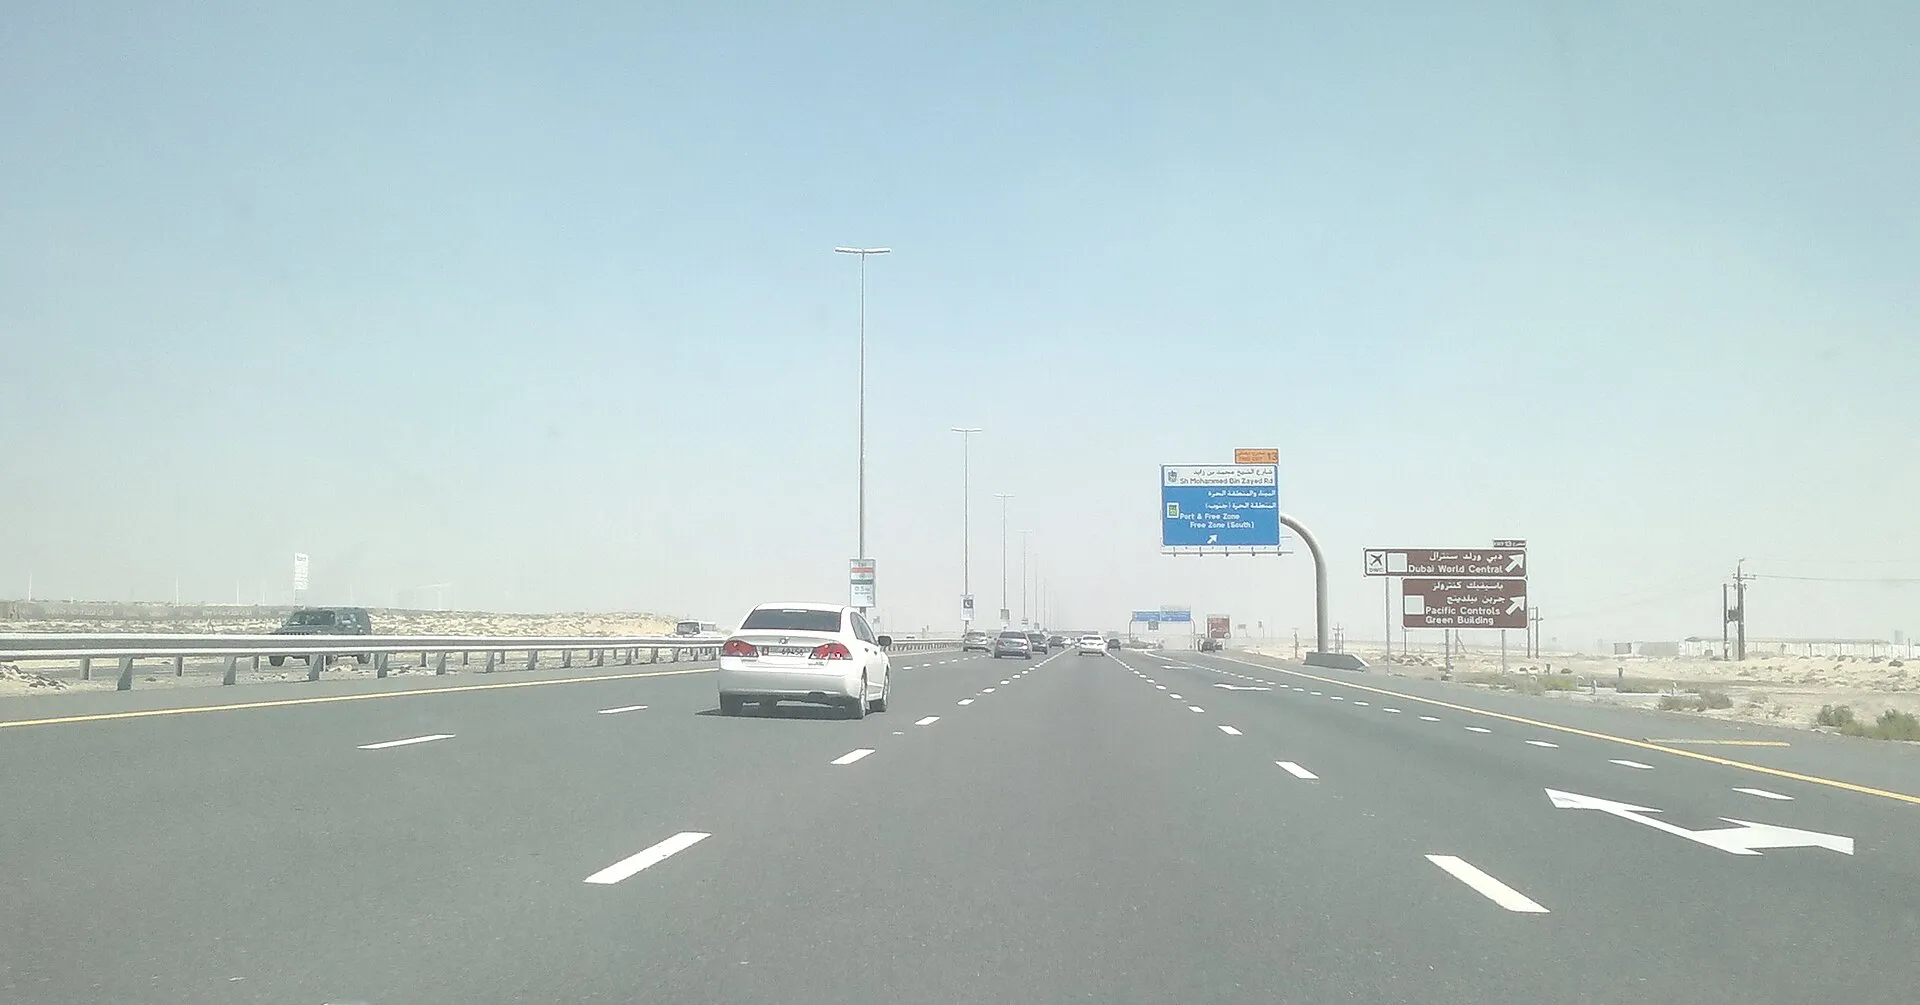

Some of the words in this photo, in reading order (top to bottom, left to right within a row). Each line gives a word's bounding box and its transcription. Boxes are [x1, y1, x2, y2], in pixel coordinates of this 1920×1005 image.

[1237, 468, 1254, 477] الشيخ
[1256, 468, 1273, 476] شارع
[1227, 521, 1255, 529] (South)
[1429, 551, 1458, 561] سنترال
[1462, 552, 1481, 562] ورلد
[1486, 554, 1503, 563] دبي
[1408, 564, 1435, 573] Dubai
[1438, 565, 1464, 573] World
[1468, 565, 1503, 573] Central
[1482, 596, 1506, 604] جرين
[1425, 606, 1456, 615] Pacific
[1460, 606, 1501, 615] Controls
[1425, 616, 1453, 624] Green
[1457, 616, 1494, 626] Building
